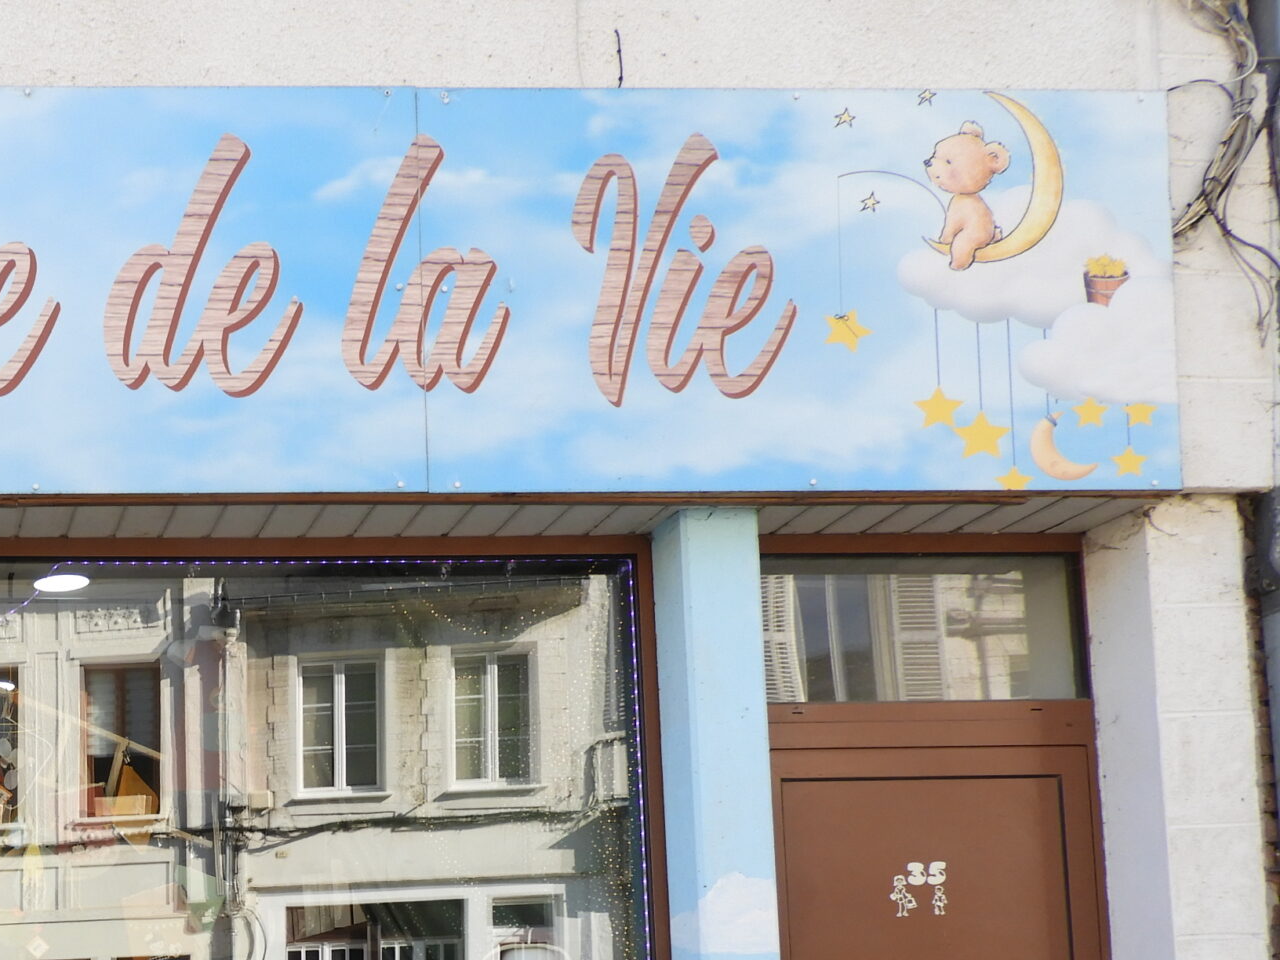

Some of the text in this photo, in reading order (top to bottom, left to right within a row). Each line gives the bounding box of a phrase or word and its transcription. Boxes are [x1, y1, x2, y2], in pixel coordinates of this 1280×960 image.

[103, 133, 304, 398] de
[342, 133, 510, 393] la
[571, 133, 797, 407] Vie
[906, 861, 947, 886] 35
